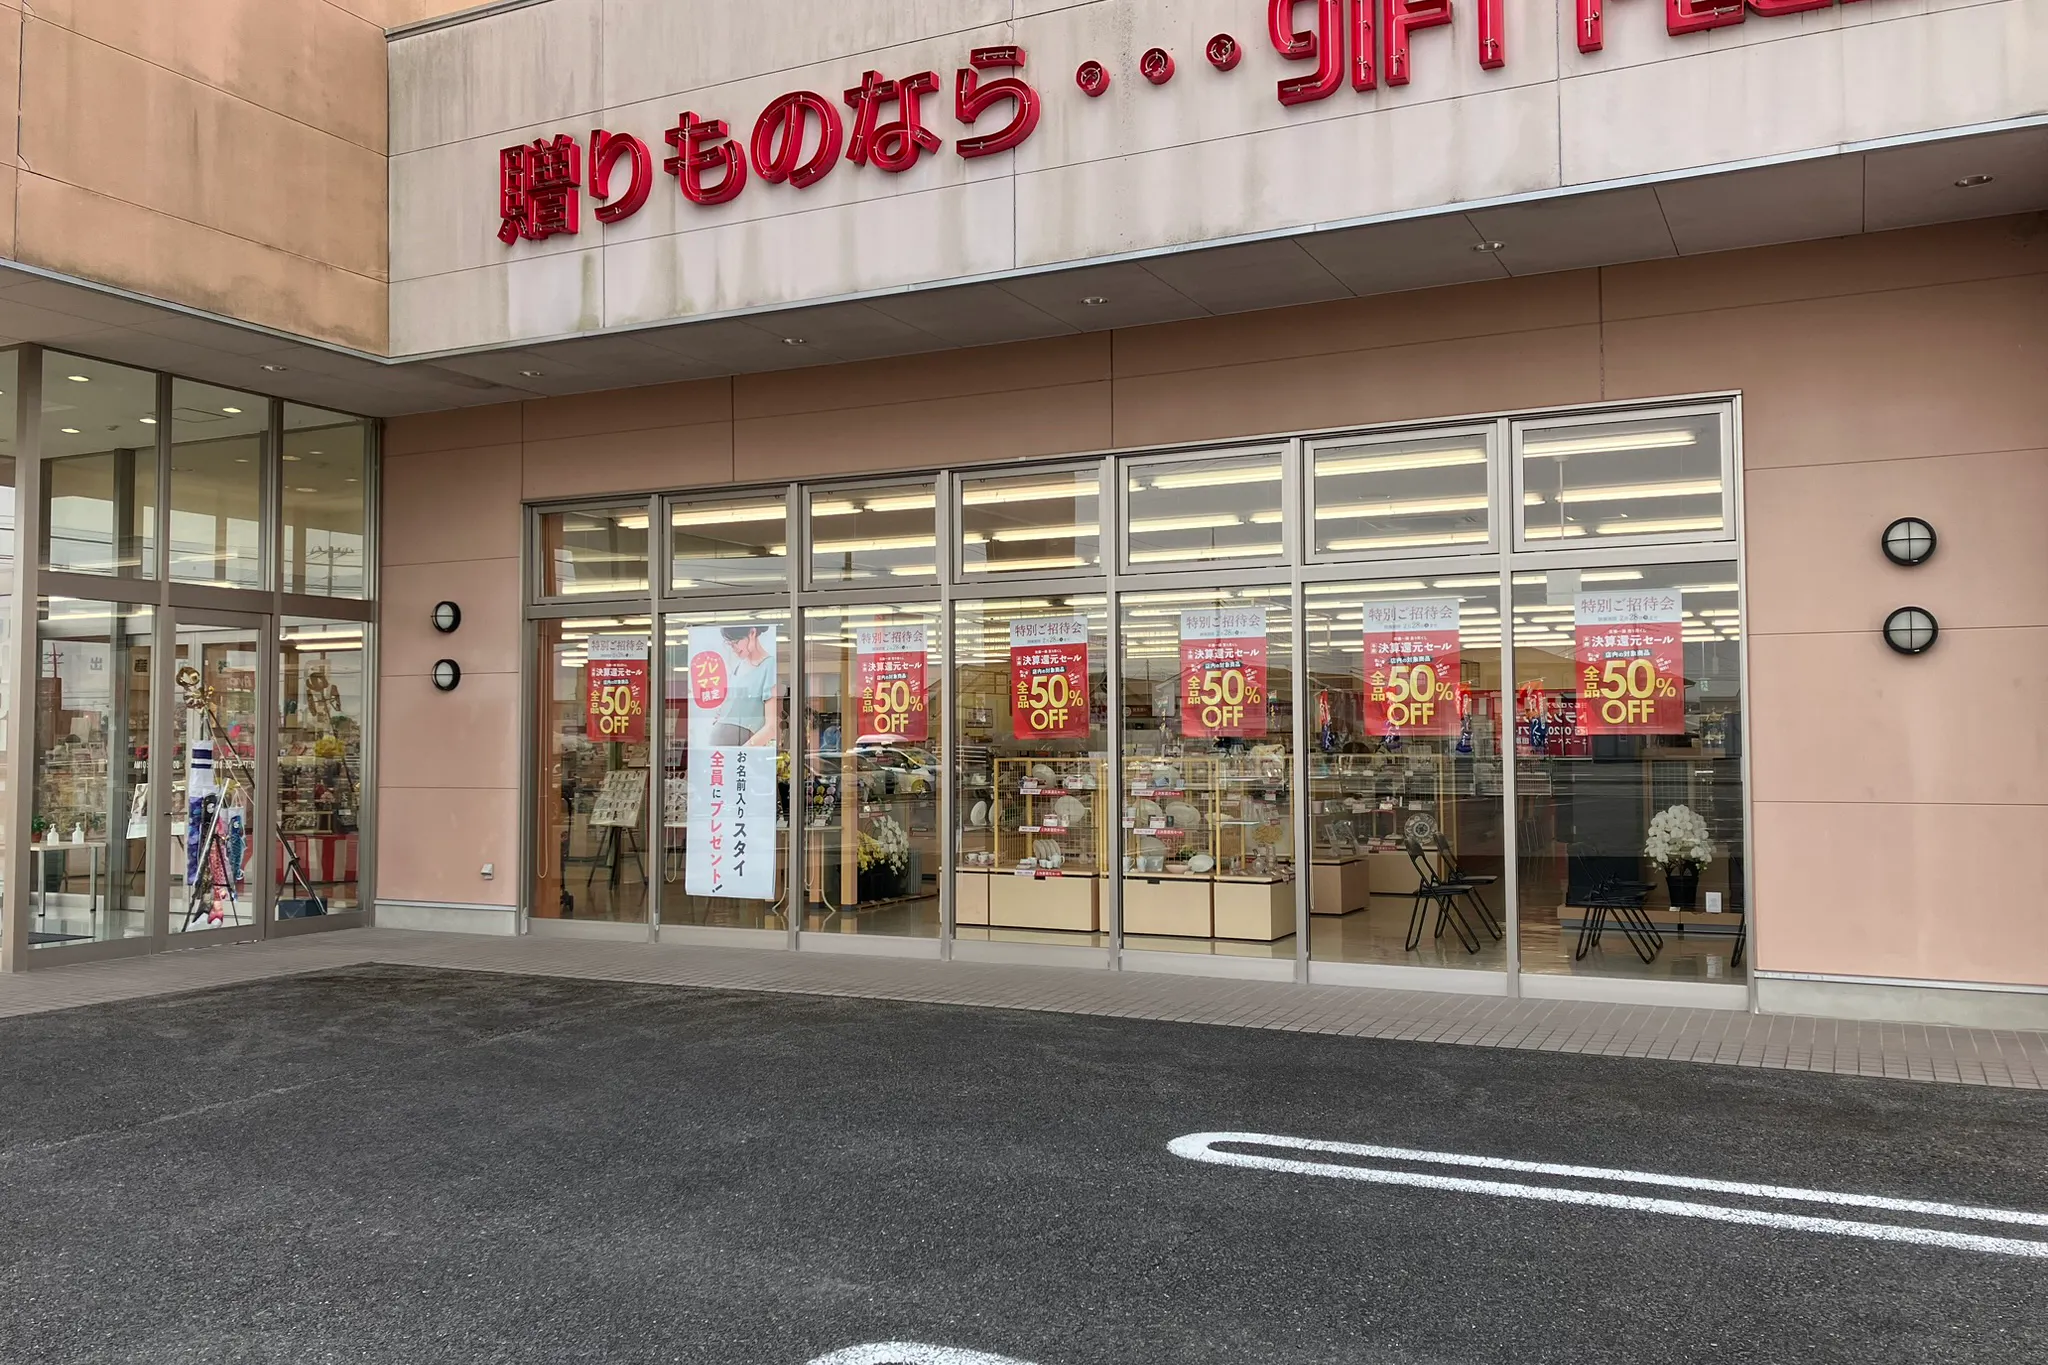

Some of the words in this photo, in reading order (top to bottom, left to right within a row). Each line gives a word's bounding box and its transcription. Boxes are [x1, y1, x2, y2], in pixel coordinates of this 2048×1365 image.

[1368, 605, 1453, 621] 特別ご招待会
[1581, 596, 1675, 613] 特別ご招待会
[1015, 621, 1082, 637] 特別ご招待会
[1186, 614, 1260, 629] 特別ご招待会
[861, 630, 923, 644] 特別ご招待会
[1592, 636, 1674, 647] 決算還元セール
[1195, 648, 1259, 659] 決算還元セール
[1378, 641, 1452, 653] 決算還元セール
[1022, 654, 1081, 666] 決算還元セール
[697, 676, 720, 688] ママ
[1187, 676, 1200, 704] 全品
[1200, 670, 1260, 705] 50%
[1370, 671, 1385, 701] 全品
[1386, 665, 1453, 702] 50%
[1584, 666, 1600, 698] 全品
[1600, 659, 1676, 700] 50%
[591, 690, 600, 714] 全品
[600, 686, 642, 715] 50%
[702, 689, 720, 702] 限定
[863, 687, 873, 713] 全品
[873, 681, 923, 713] 50%
[1017, 681, 1029, 708] 全品
[1029, 675, 1083, 709] 50%
[1031, 709, 1068, 730] OFF
[1202, 706, 1243, 728] OFF
[1387, 703, 1434, 726] OFF
[1602, 700, 1654, 724] OFF
[600, 716, 629, 734] OFF
[874, 713, 909, 733] OFF
[732, 751, 748, 877] お名前入りスタイ
